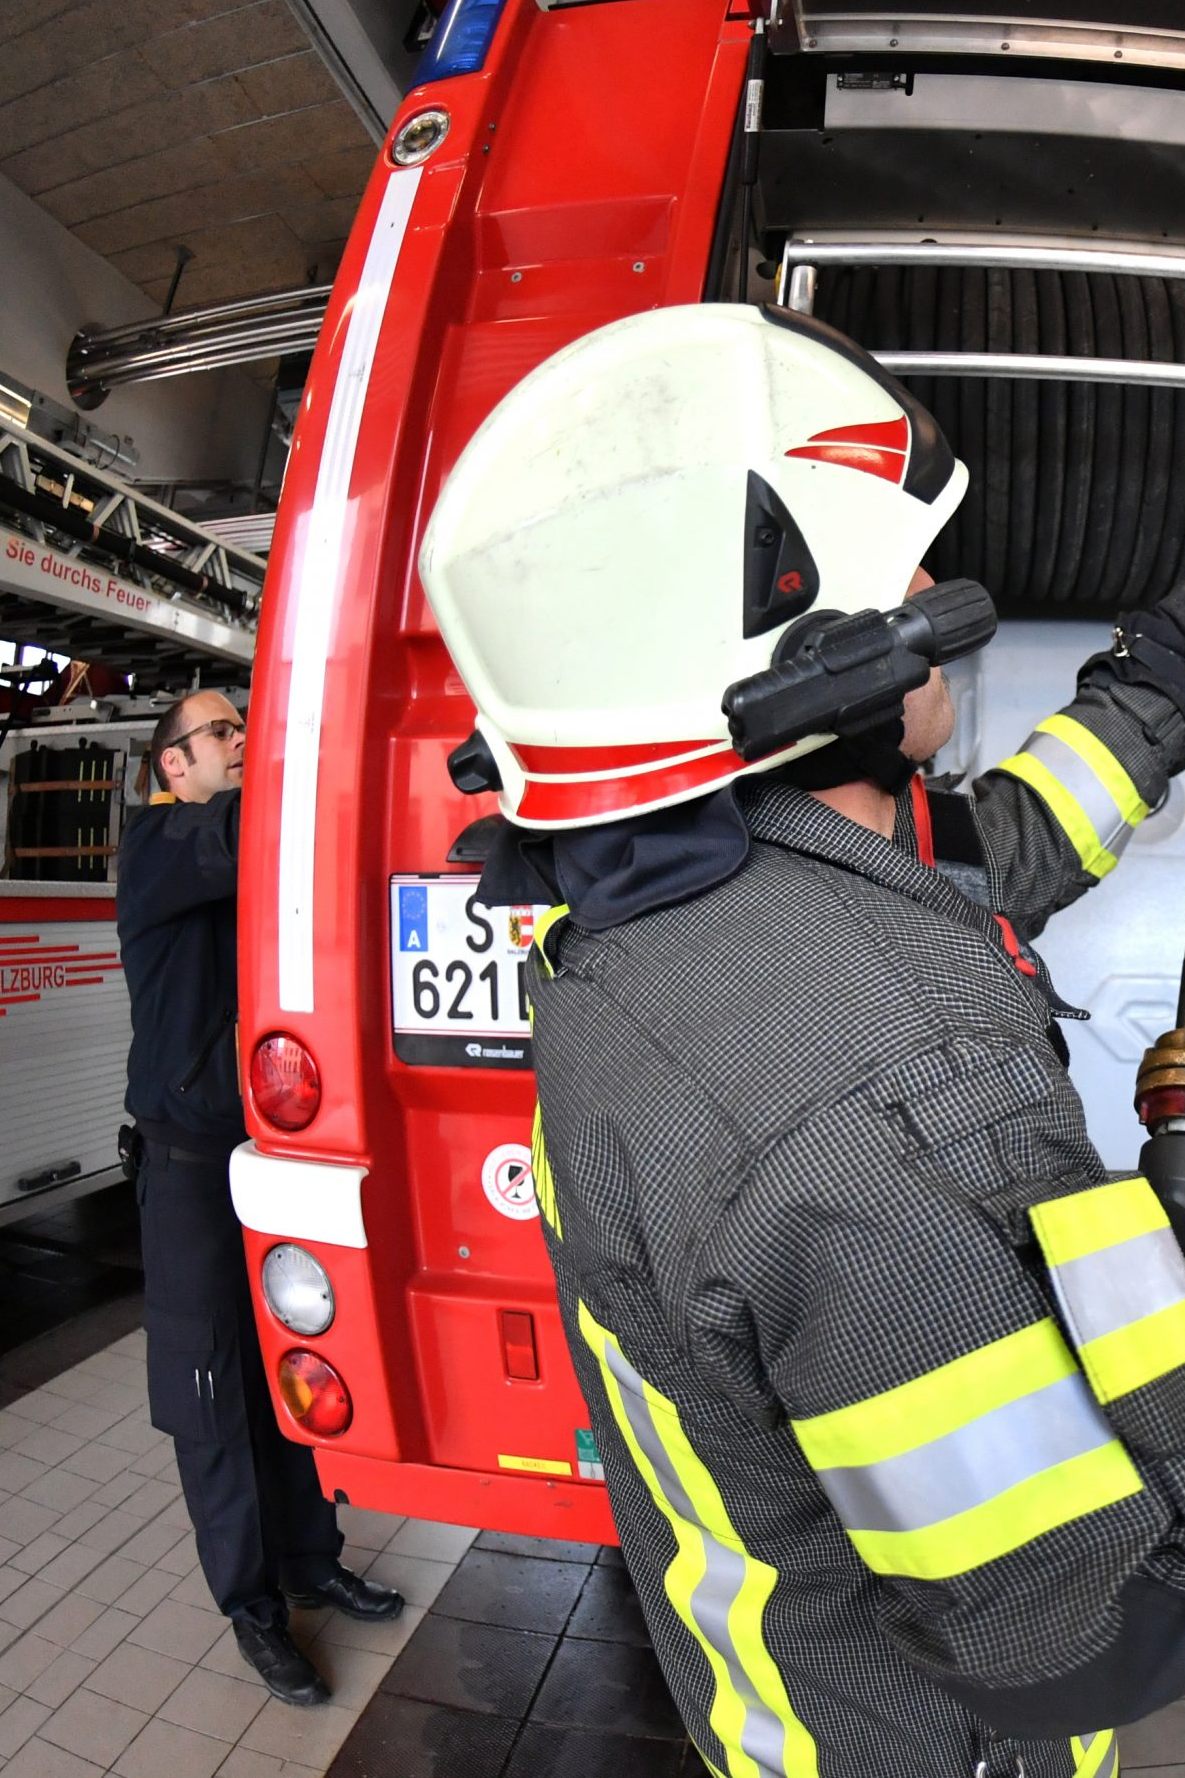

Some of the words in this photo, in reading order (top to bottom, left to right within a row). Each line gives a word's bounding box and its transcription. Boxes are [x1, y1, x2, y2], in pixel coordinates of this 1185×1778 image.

[6, 538, 35, 566] Sie
[41, 554, 101, 594] durchs
[106, 579, 152, 613] Feuer
[407, 930, 421, 948] A
